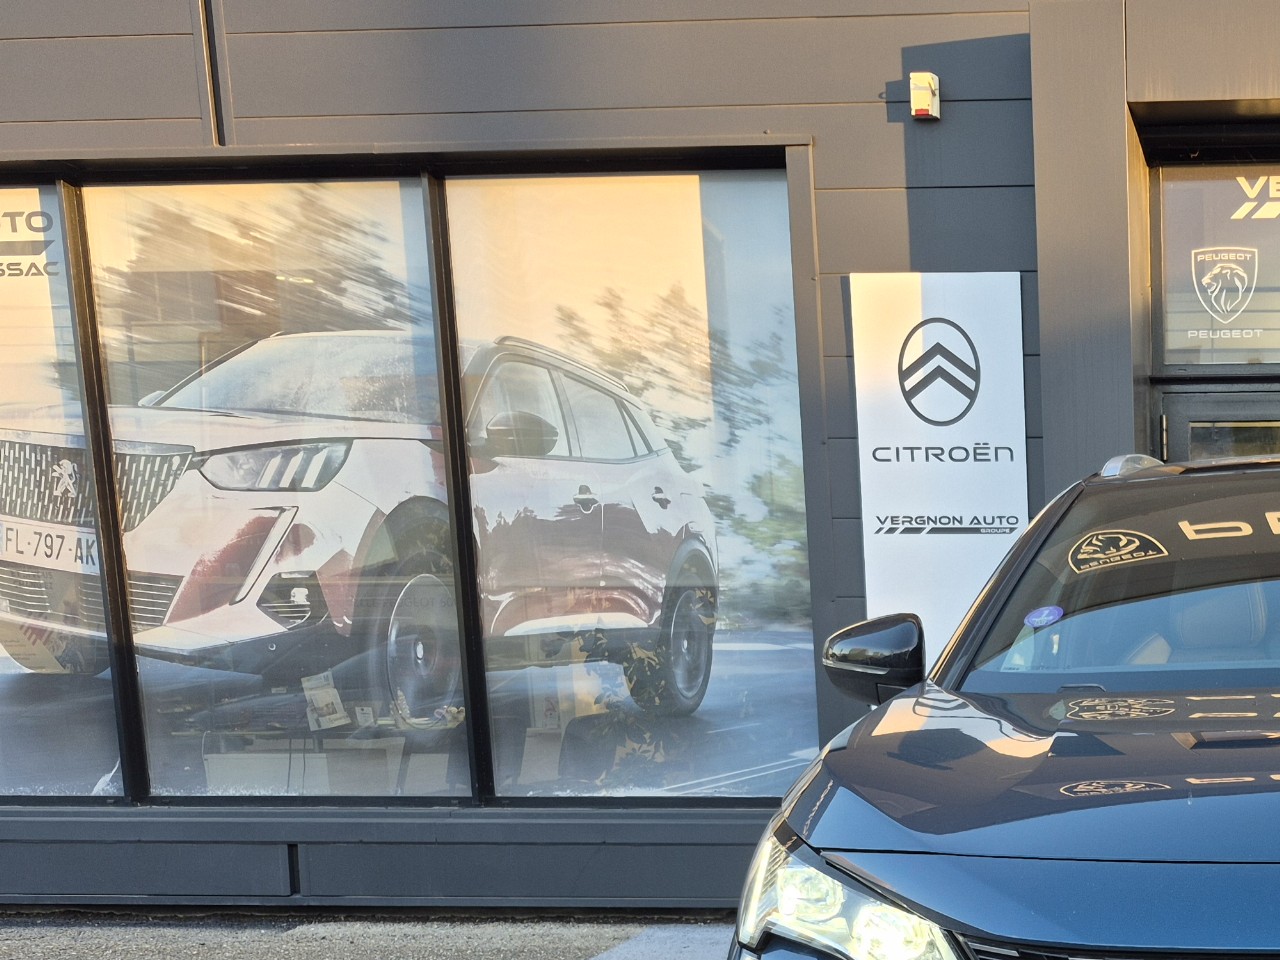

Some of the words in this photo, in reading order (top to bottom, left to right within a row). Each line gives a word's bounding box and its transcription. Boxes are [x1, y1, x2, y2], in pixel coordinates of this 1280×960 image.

[0, 211, 54, 233] TO
[1197, 253, 1252, 262] PEUGEOT
[1188, 329, 1263, 338] PEUGEOT
[875, 515, 963, 526] VERGNON
[968, 515, 1019, 525] AUTO
